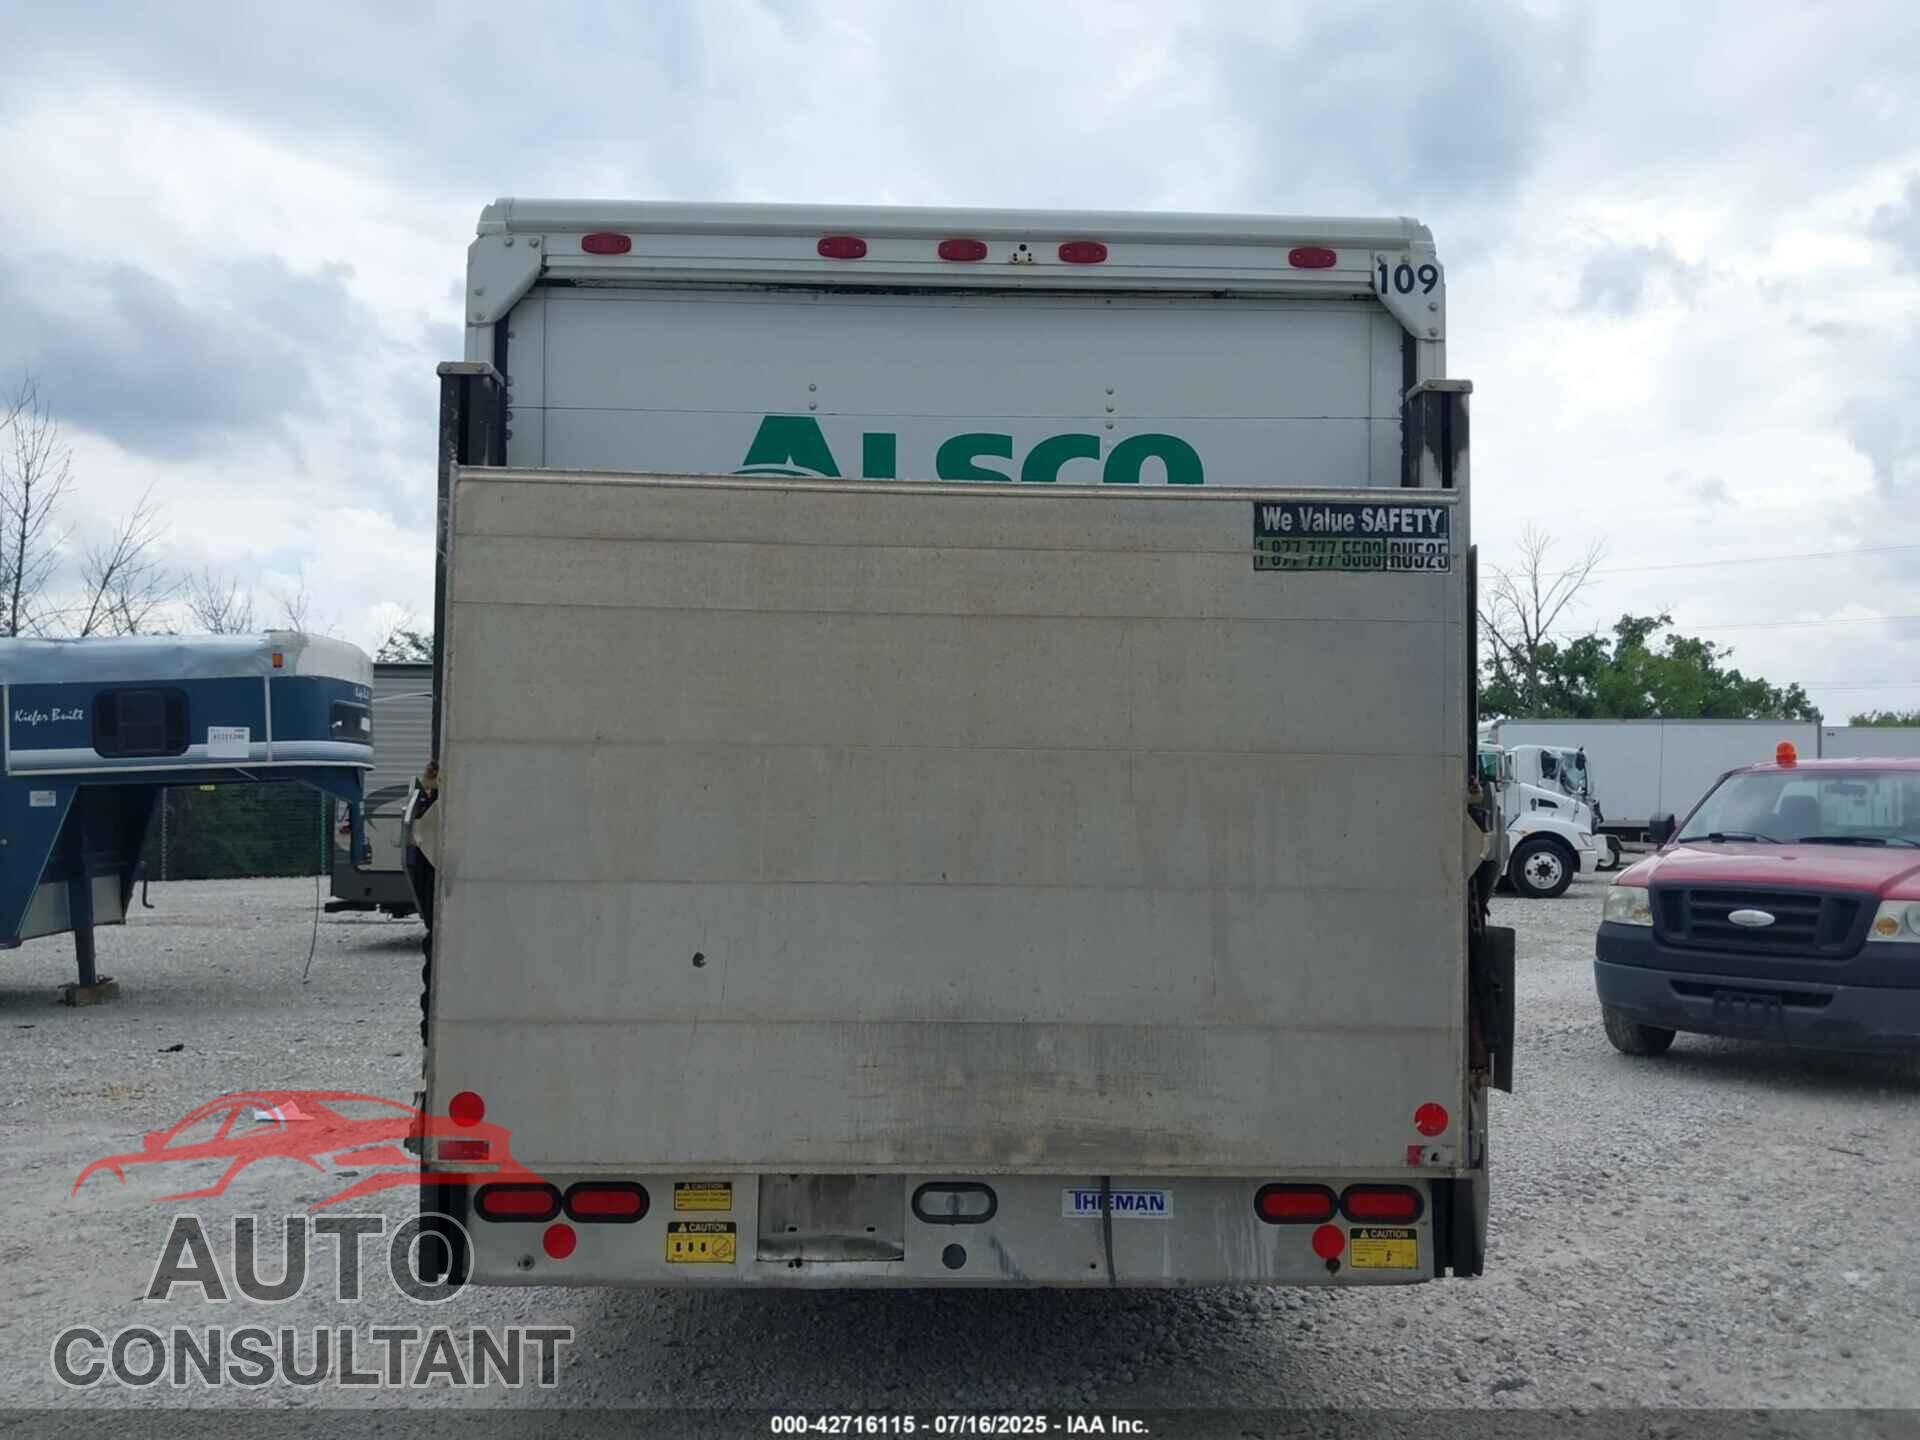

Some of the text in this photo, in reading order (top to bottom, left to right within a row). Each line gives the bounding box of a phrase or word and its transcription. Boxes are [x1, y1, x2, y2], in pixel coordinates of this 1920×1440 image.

[1378, 263, 1439, 295] 109
[1262, 506, 1443, 533] We Value SAFETY
[14, 707, 84, 726] Kiefer Built
[688, 1223, 728, 1232] CAUTION
[1370, 1229, 1409, 1239] CAUTION
